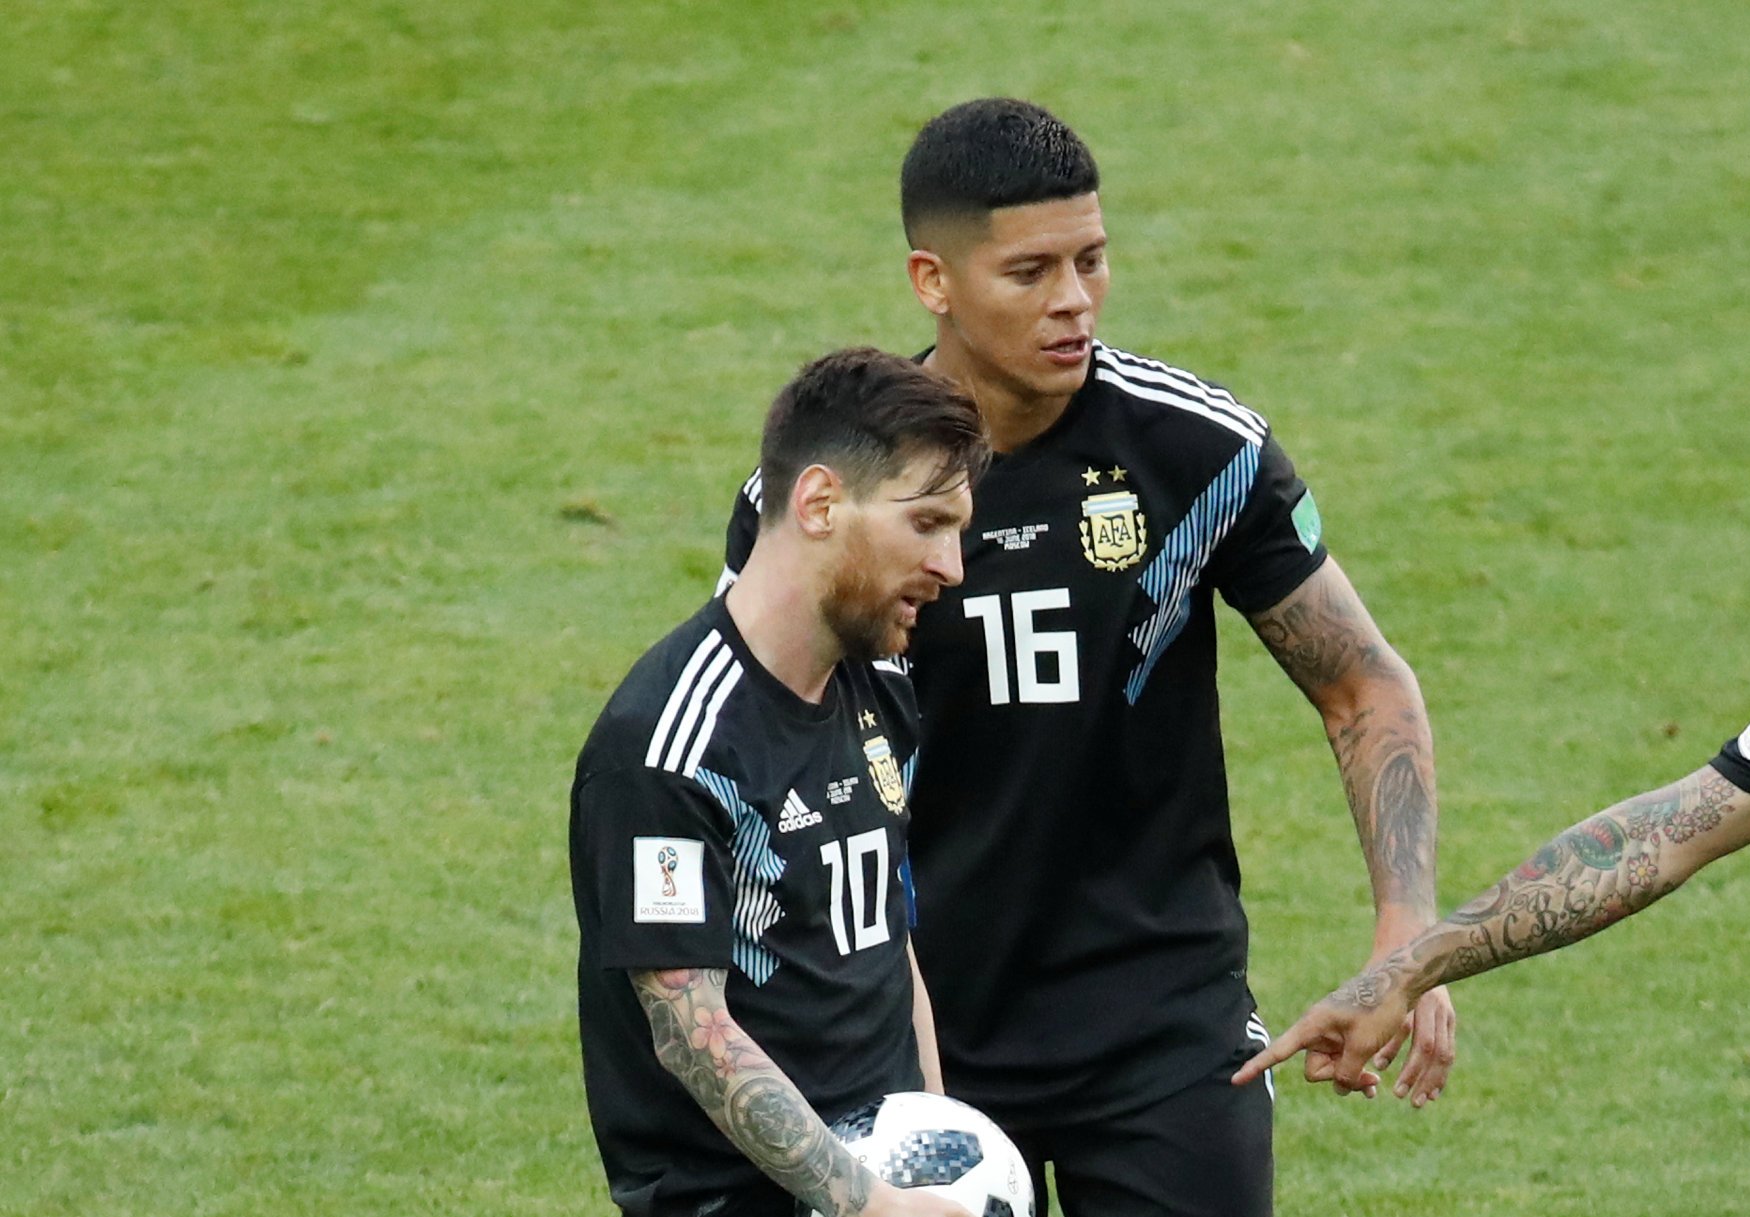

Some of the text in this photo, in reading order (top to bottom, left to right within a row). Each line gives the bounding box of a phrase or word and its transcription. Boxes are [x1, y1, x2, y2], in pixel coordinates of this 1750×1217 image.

[1098, 513, 1132, 547] AFA
[963, 587, 1080, 705] 16
[778, 811, 823, 833] adidas
[820, 827, 891, 956] 10
[640, 907, 676, 916] RUSSIA
